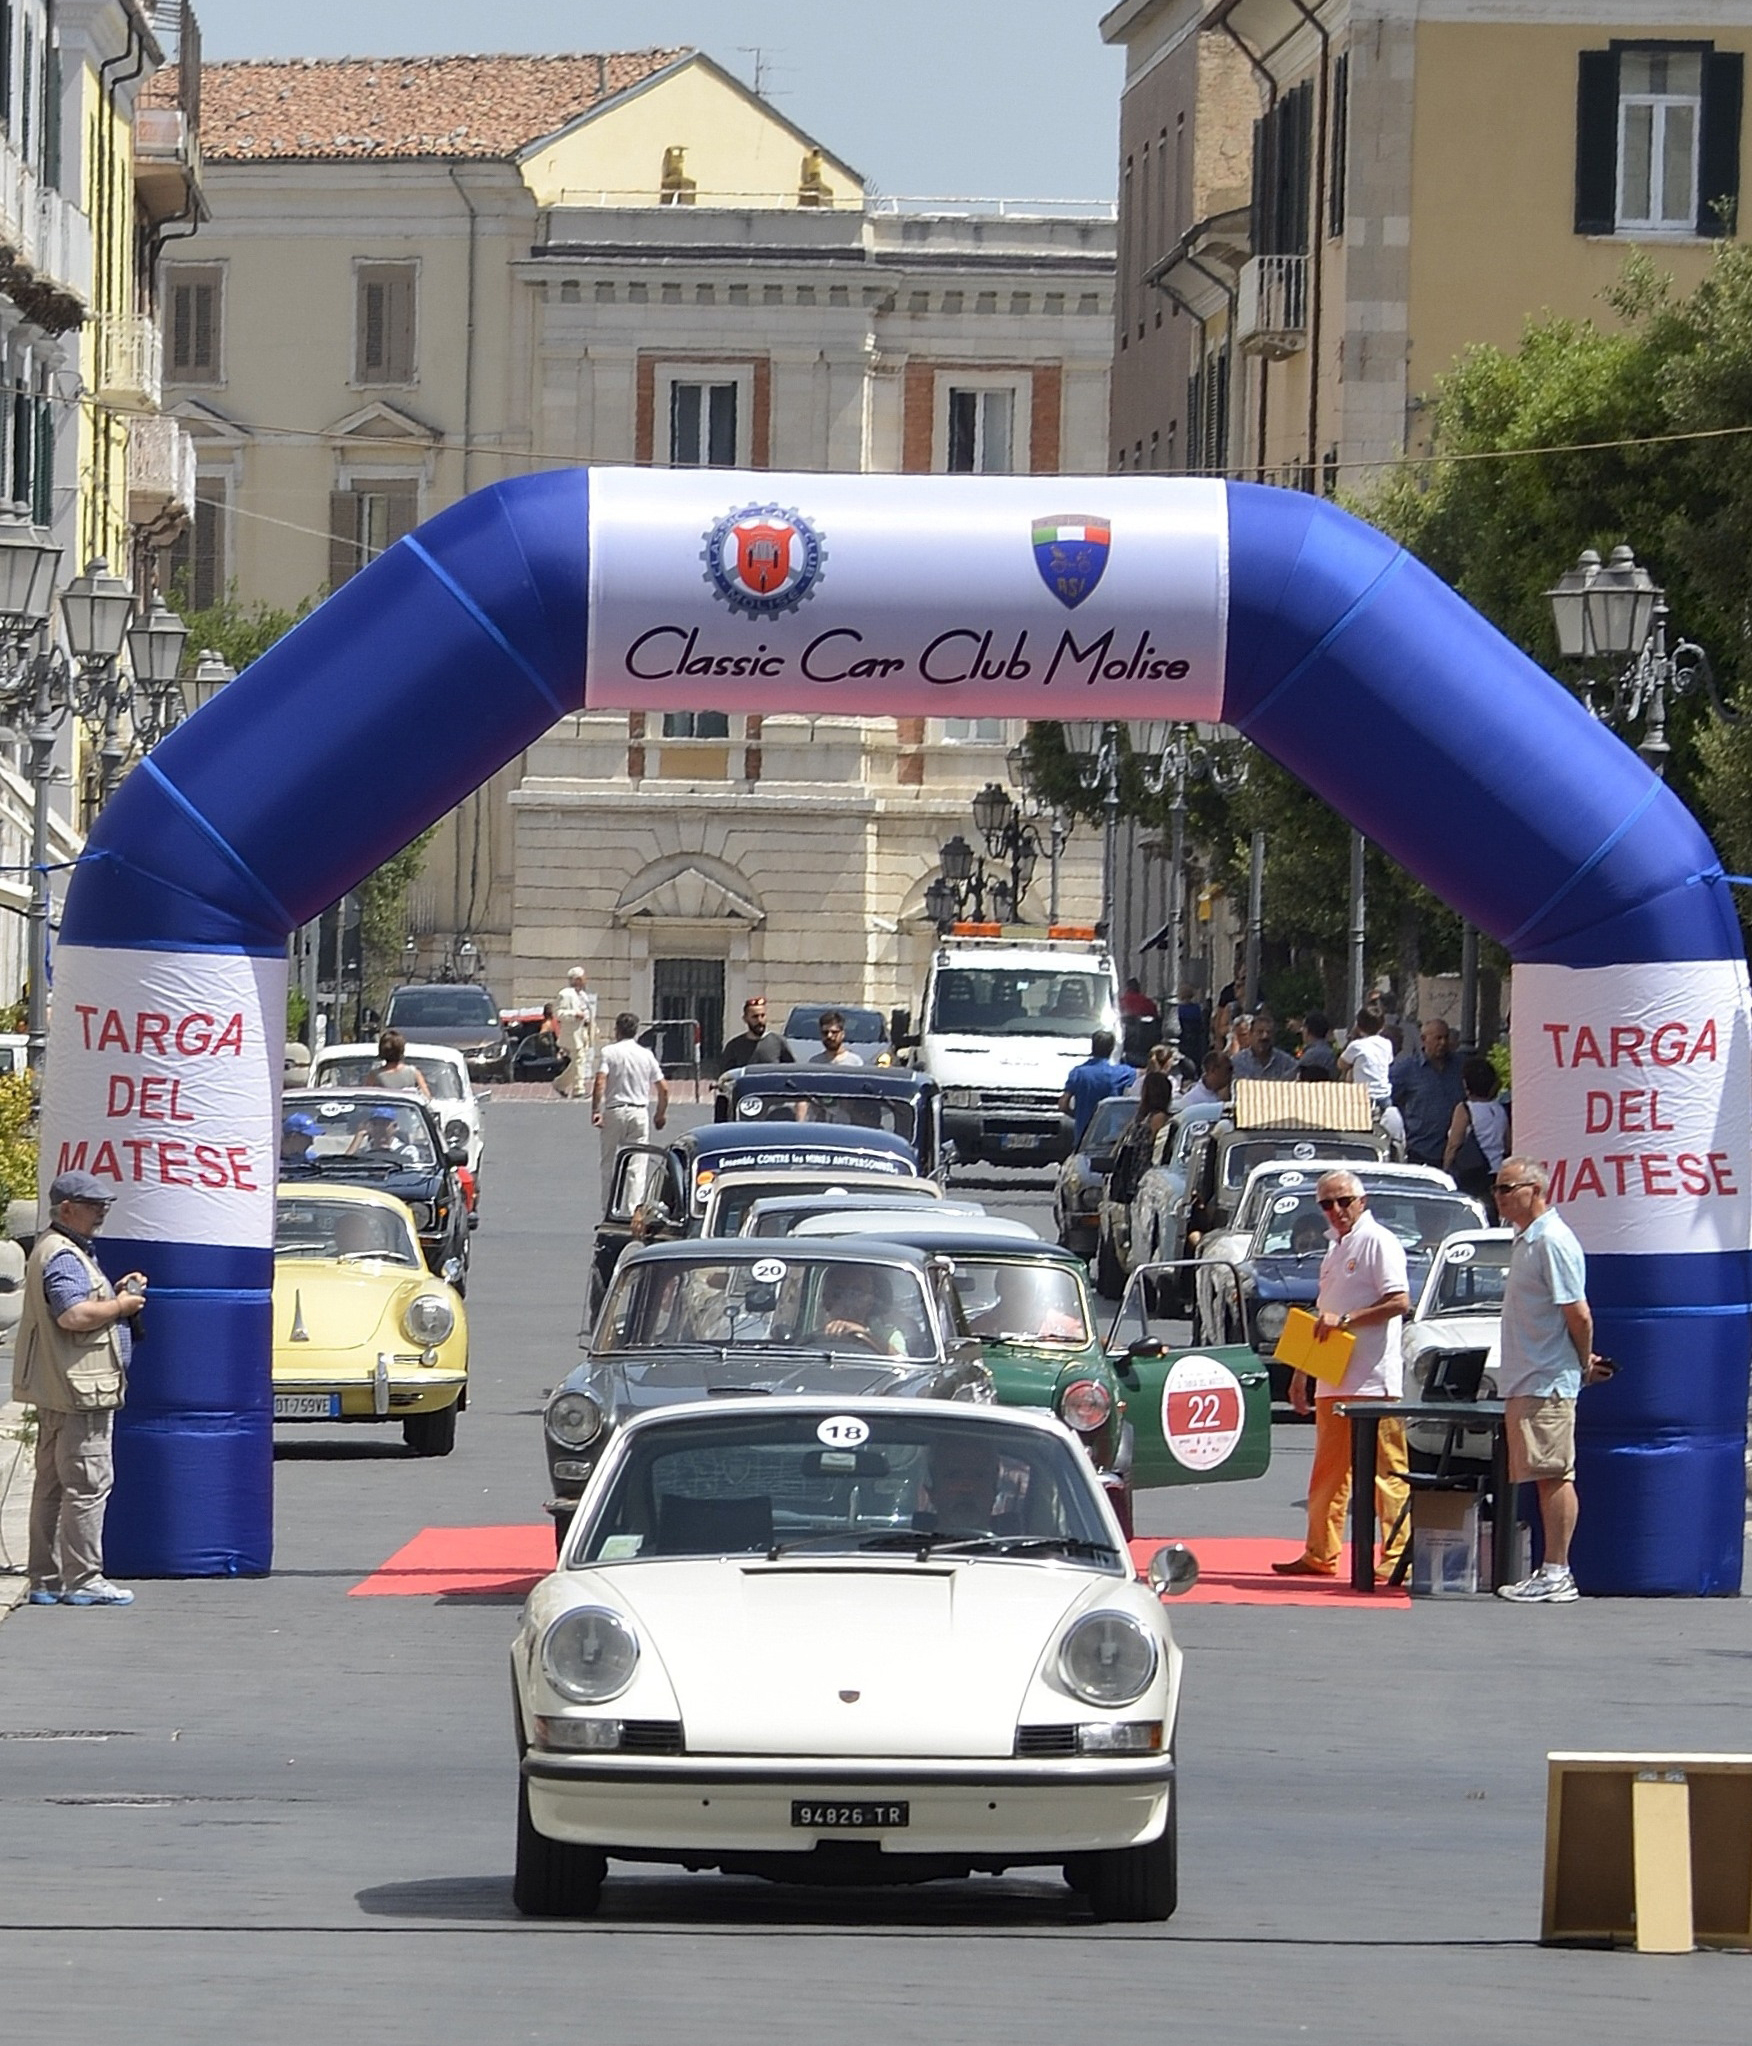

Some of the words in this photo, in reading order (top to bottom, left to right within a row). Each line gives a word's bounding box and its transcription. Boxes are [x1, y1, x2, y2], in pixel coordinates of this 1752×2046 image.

[727, 588, 801, 610] MOLISE
[1057, 577, 1085, 598] ASI
[625, 625, 785, 680] Classic
[800, 627, 905, 683] Car
[919, 628, 1031, 685] Club
[1043, 626, 1190, 685] Molise
[75, 1004, 244, 1056] TARGA
[1542, 1018, 1718, 1068] TARGA
[106, 1075, 195, 1121] DEL
[1585, 1089, 1674, 1134] DEL
[56, 1140, 258, 1191] MATESE
[757, 1265, 782, 1277] 20
[1188, 1394, 1220, 1429] 22
[825, 1425, 863, 1440] 18
[801, 1807, 863, 1824] 94826
[874, 1807, 900, 1823] TR
